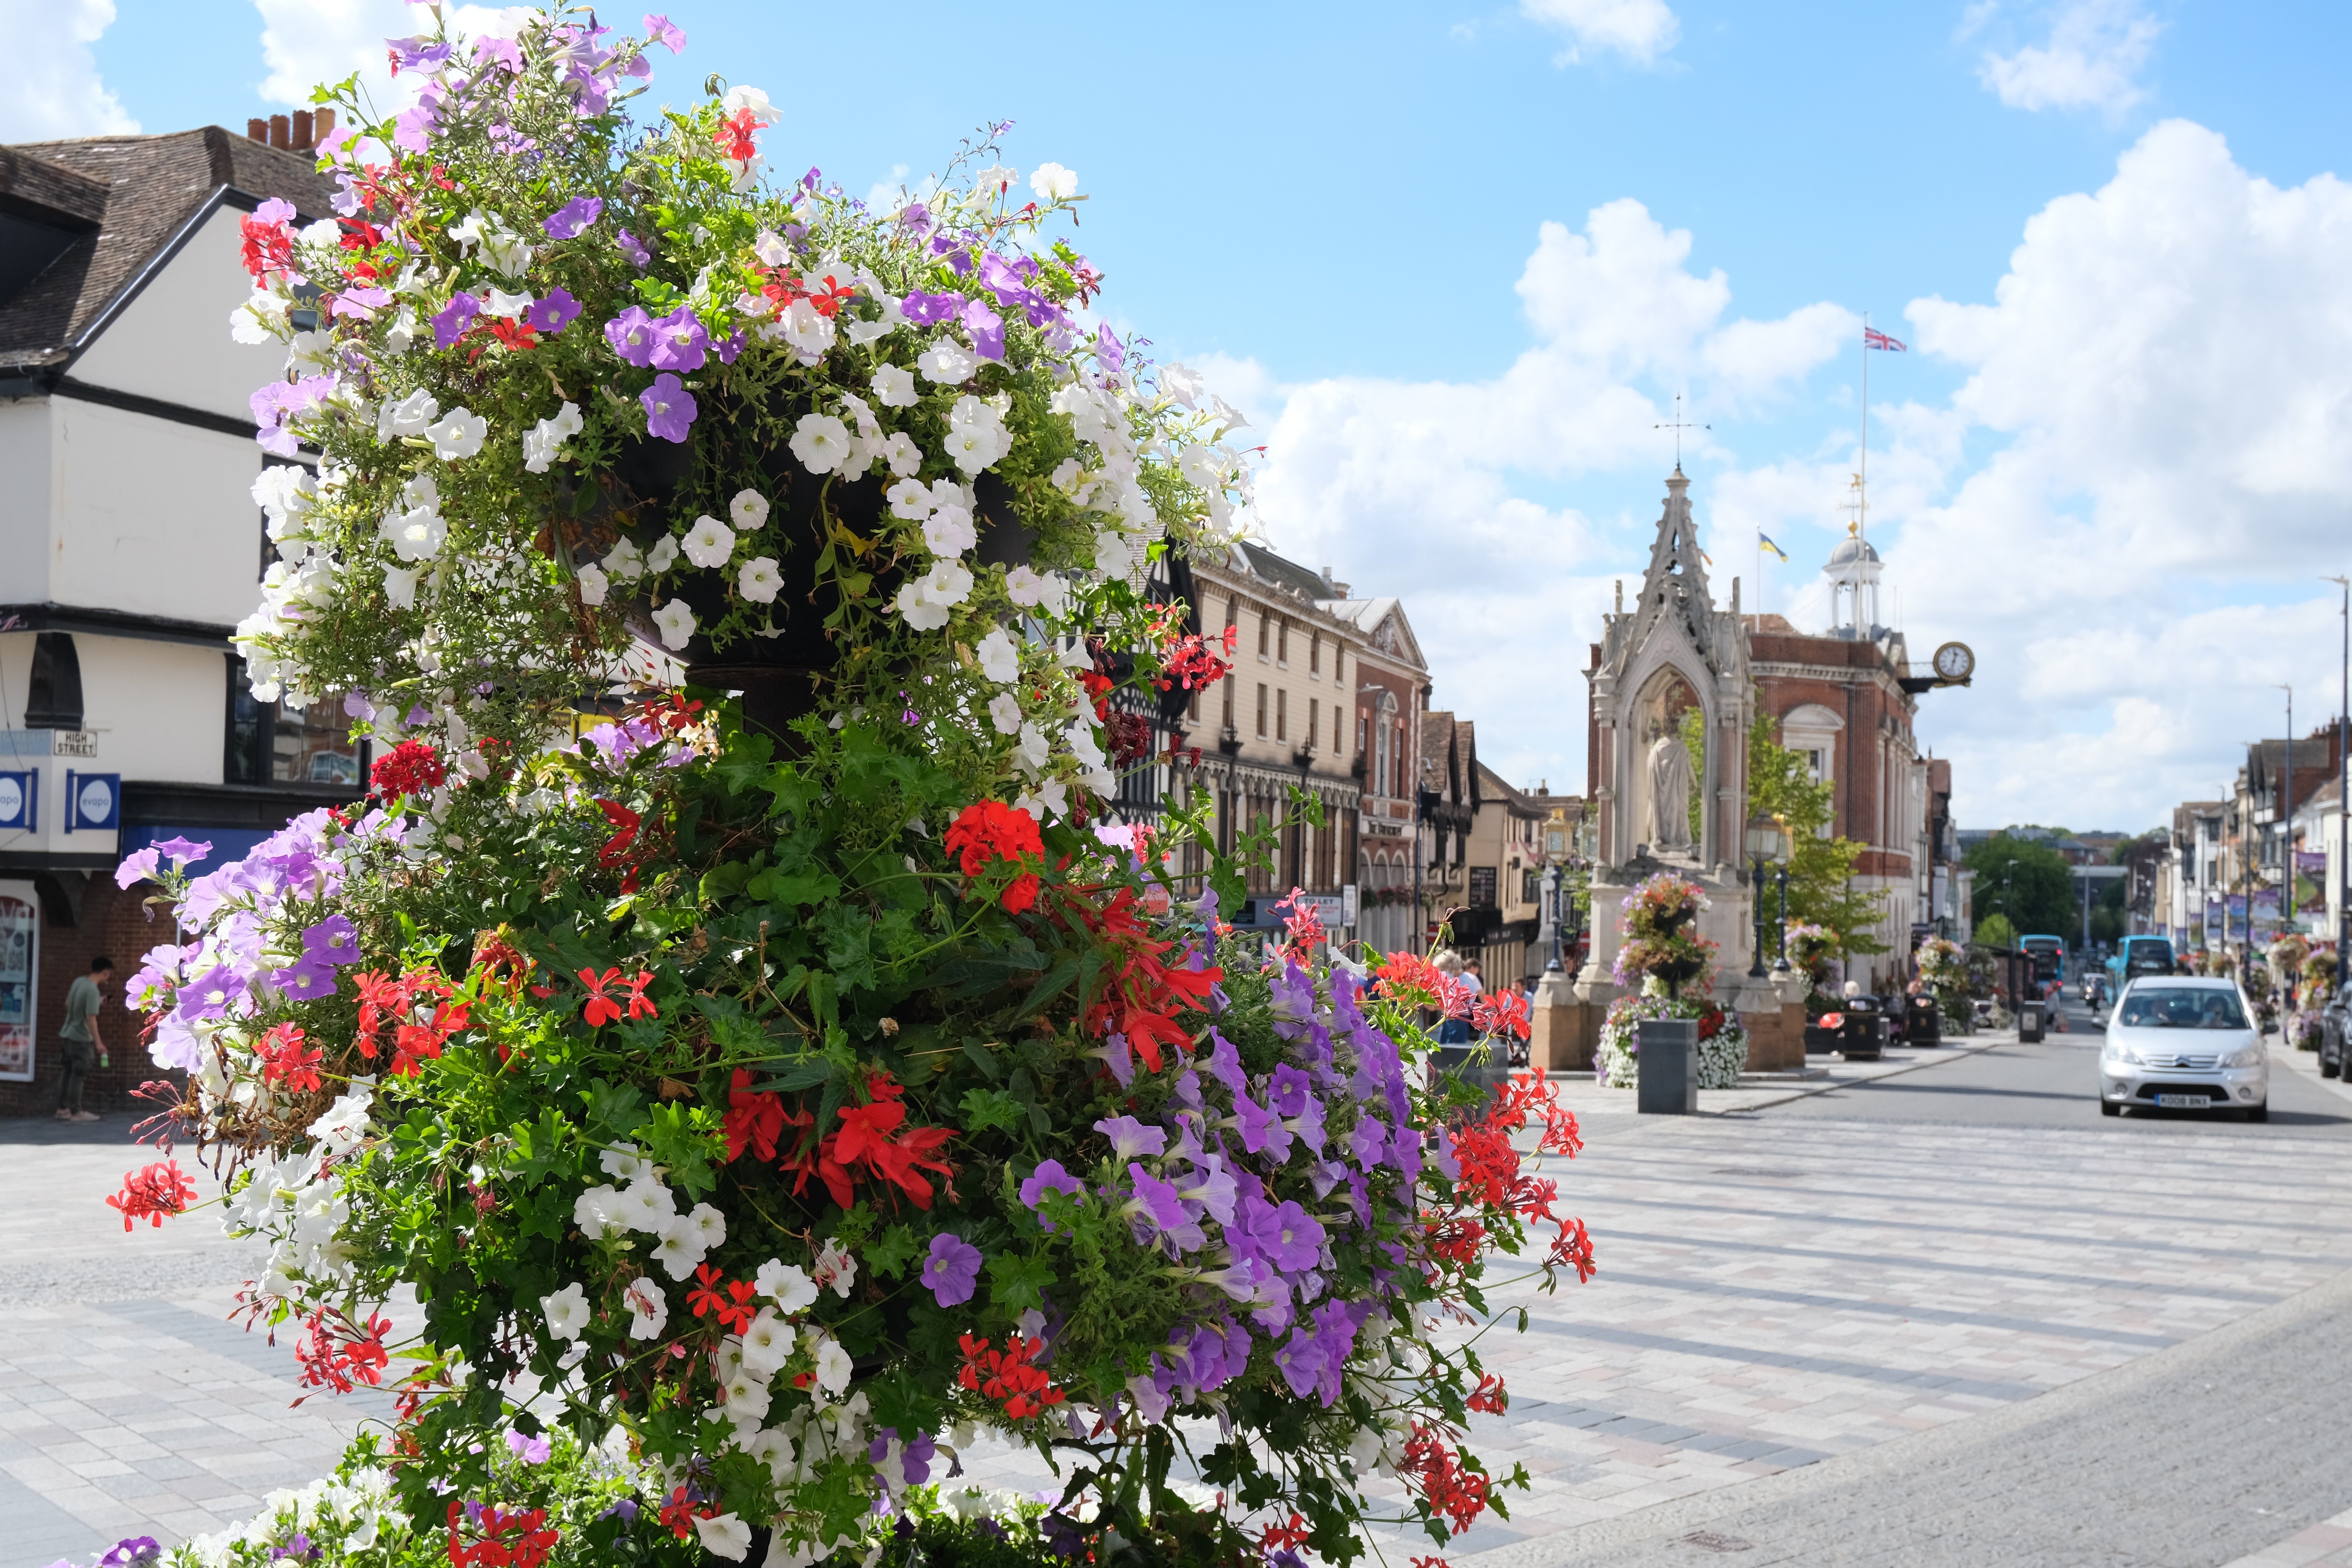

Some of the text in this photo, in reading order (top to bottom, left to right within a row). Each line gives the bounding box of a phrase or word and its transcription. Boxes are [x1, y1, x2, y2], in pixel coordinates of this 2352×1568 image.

[66, 733, 87, 743] HIGH
[58, 743, 93, 754] STREET
[0, 795, 19, 806] apo
[82, 798, 109, 809] evapo
